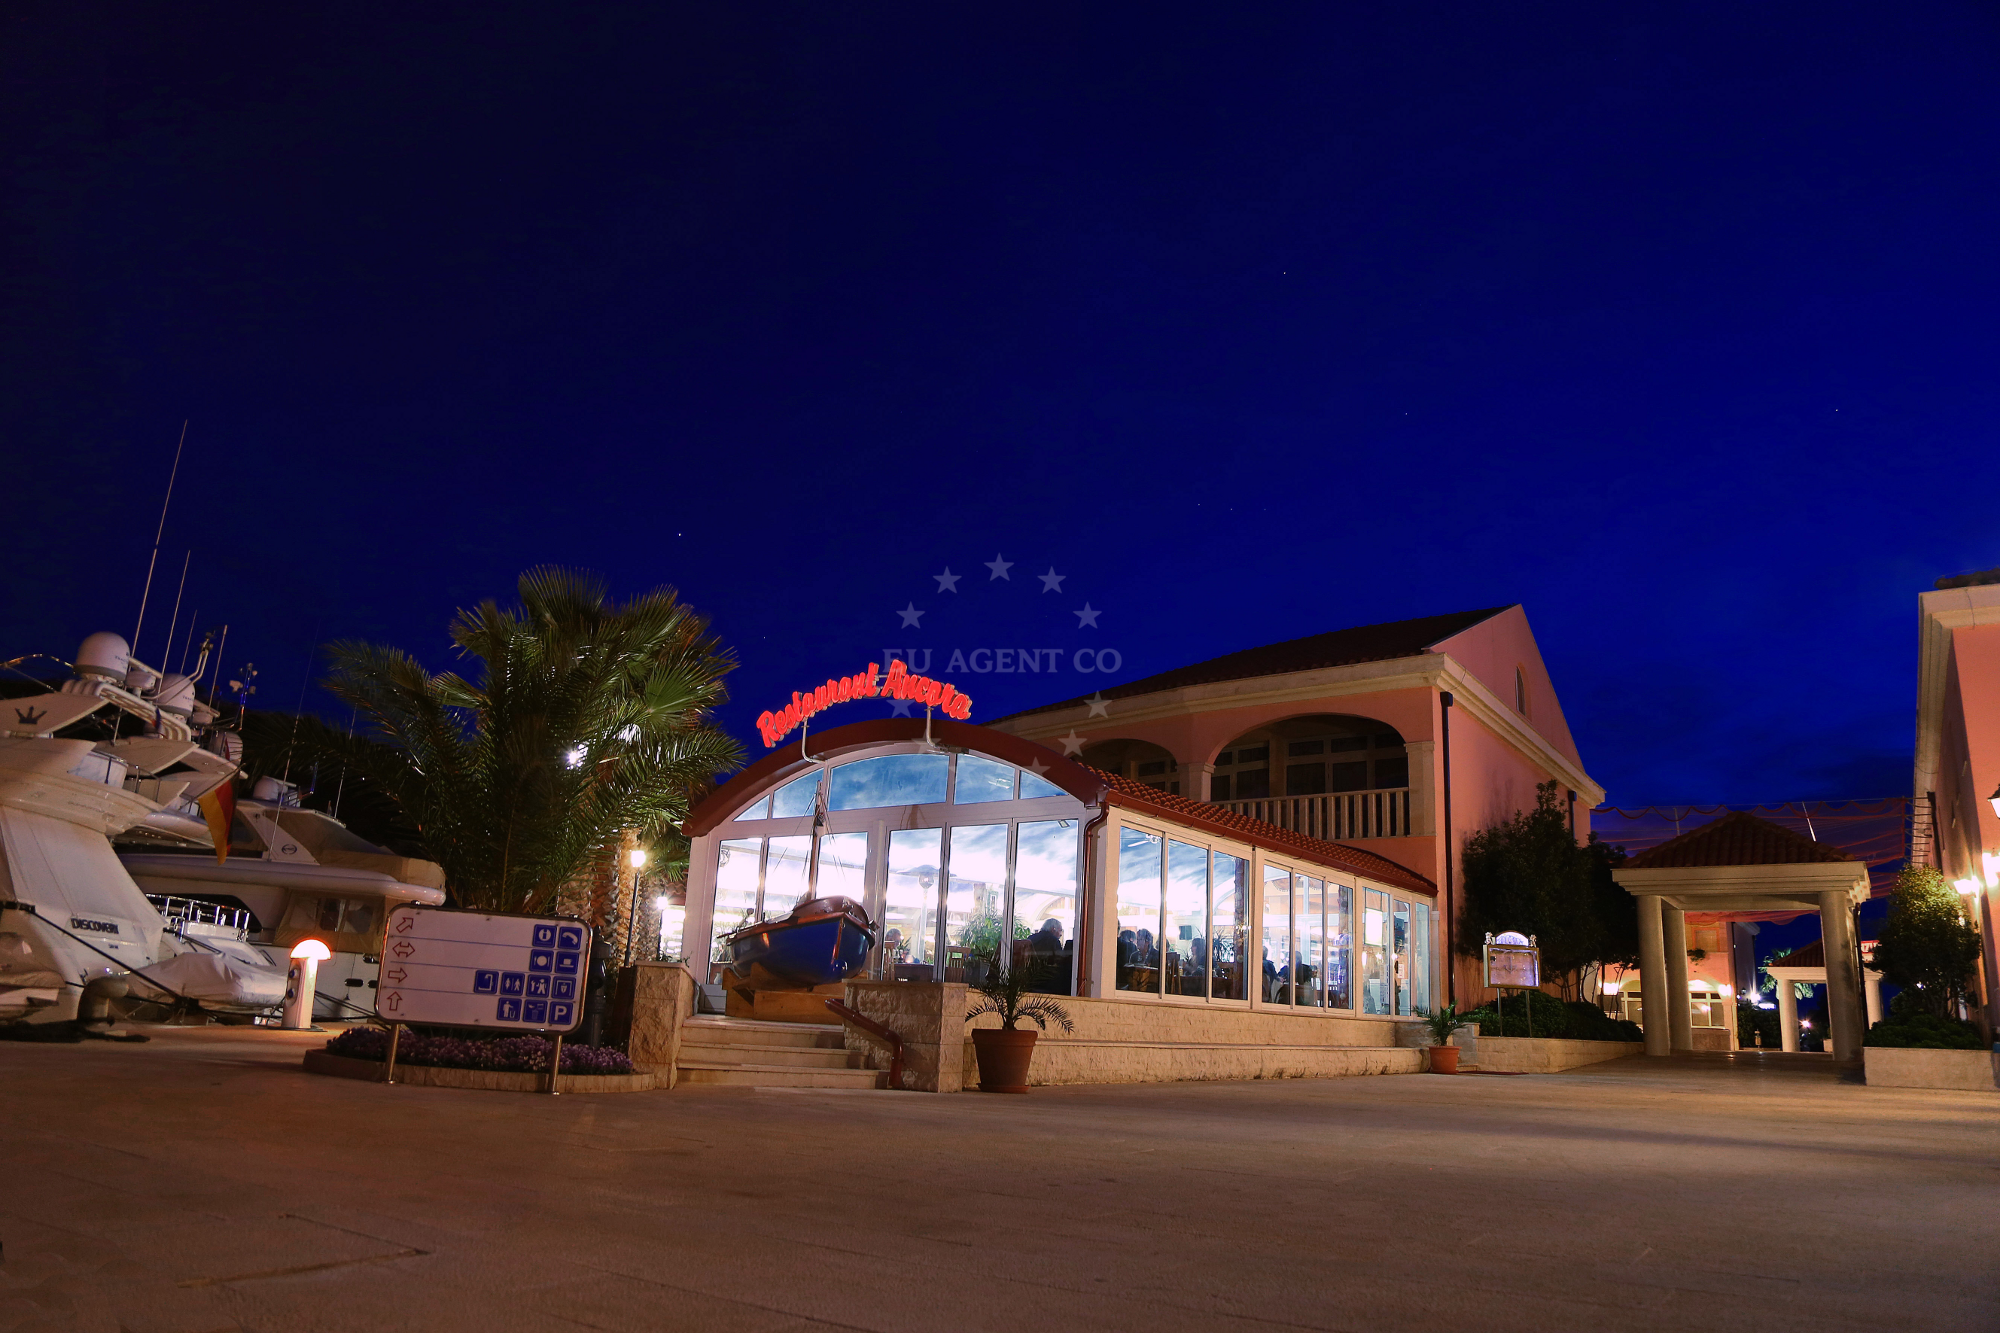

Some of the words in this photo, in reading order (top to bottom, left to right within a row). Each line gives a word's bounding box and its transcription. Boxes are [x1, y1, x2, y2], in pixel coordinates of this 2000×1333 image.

[756, 662, 879, 748] Restaurant
[881, 659, 972, 720] Ancora
[554, 1005, 567, 1021] P
